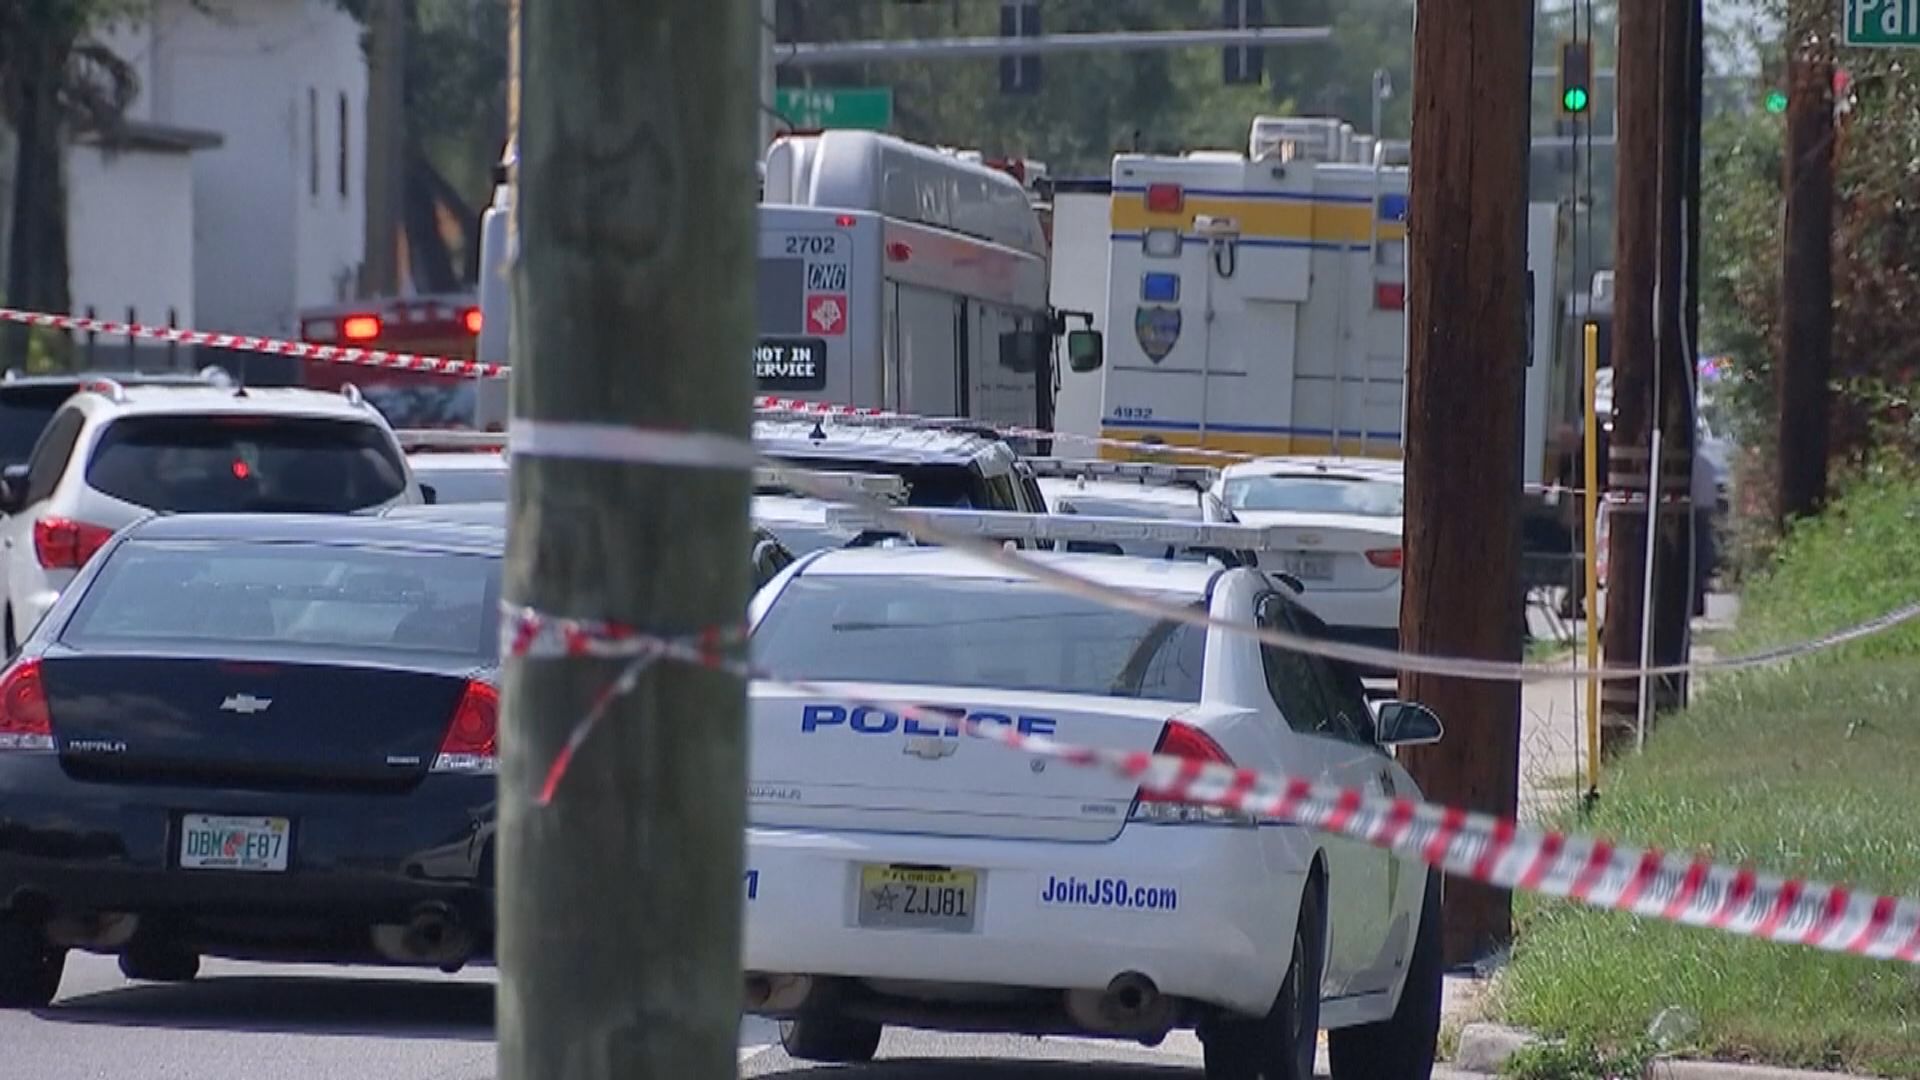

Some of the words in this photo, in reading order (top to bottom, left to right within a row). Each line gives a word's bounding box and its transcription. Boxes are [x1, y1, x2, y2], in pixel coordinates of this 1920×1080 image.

[785, 236, 835, 254] 2702
[808, 263, 846, 290] CNG
[752, 347, 784, 361] NOT
[791, 347, 811, 361] IN
[753, 362, 816, 377] ERVICE
[1113, 405, 1153, 419] 4932
[890, 871, 945, 883] FLORIDA
[904, 885, 968, 917] ZJJ81
[1042, 876, 1177, 910] JoinJSO.com
